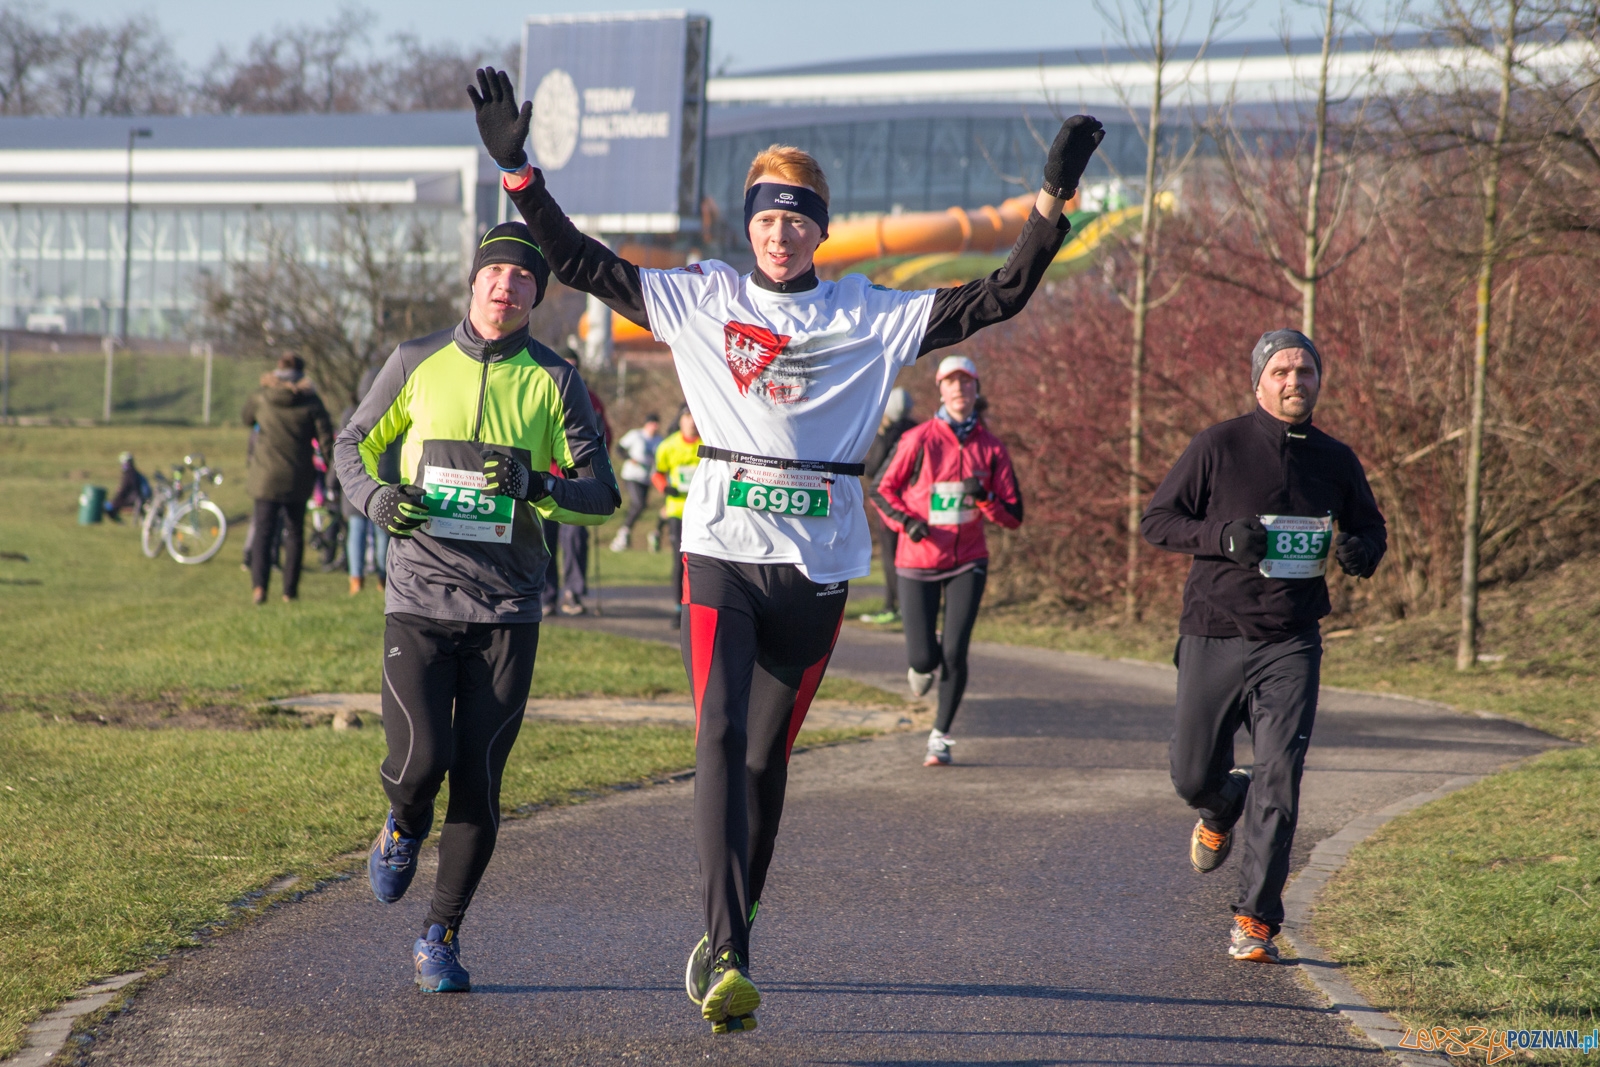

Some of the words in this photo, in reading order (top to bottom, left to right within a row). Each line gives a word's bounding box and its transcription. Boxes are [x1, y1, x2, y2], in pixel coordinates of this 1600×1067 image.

[740, 455, 778, 465] performance
[762, 470, 778, 478] BIEG
[446, 479, 476, 487] RYSZARDA
[757, 477, 790, 486] RYSZARDA
[791, 480, 821, 488] BURGIELA
[438, 486, 496, 515] 755
[746, 485, 811, 515] 699
[452, 512, 478, 520] MARCIN
[1276, 532, 1325, 554] 835
